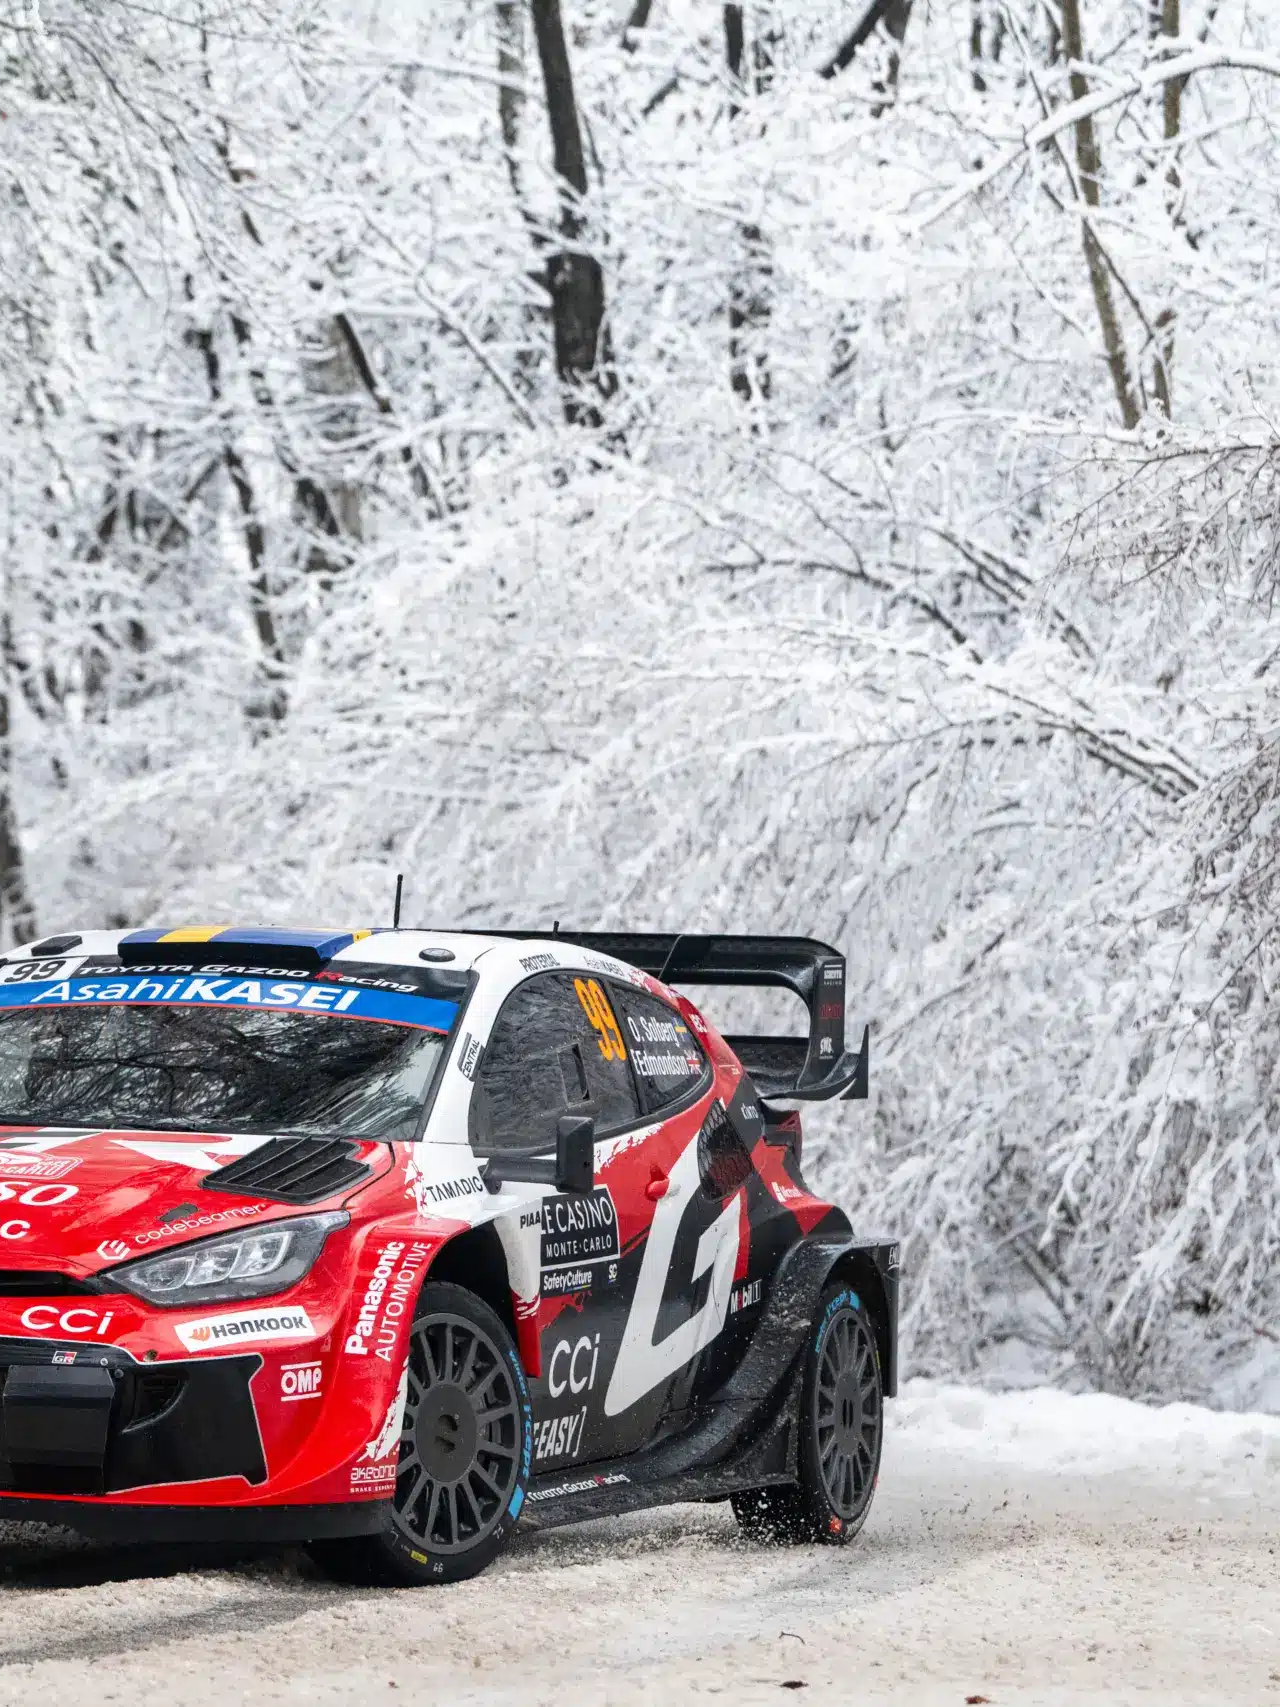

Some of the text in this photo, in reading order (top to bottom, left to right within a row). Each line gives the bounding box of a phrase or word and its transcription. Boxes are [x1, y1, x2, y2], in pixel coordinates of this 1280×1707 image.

[15, 962, 64, 983] 99
[80, 964, 420, 994] TOYOTA GAZOO Racing
[573, 978, 627, 1061] 99
[640, 1016, 680, 1048] Solberg
[462, 1039, 480, 1079] CENTRAL
[426, 1176, 484, 1202] TAMADIC
[520, 1211, 540, 1230] PIAA
[555, 1196, 613, 1233] CASINO
[543, 1269, 592, 1292] SafetyCulture
[345, 1241, 405, 1356] Panasonic
[374, 1241, 433, 1363] AUTOMOTIVE
[281, 1367, 322, 1394] OMP
[527, 1487, 565, 1502] TOYOTA
[562, 1479, 598, 1493] GAZOO
